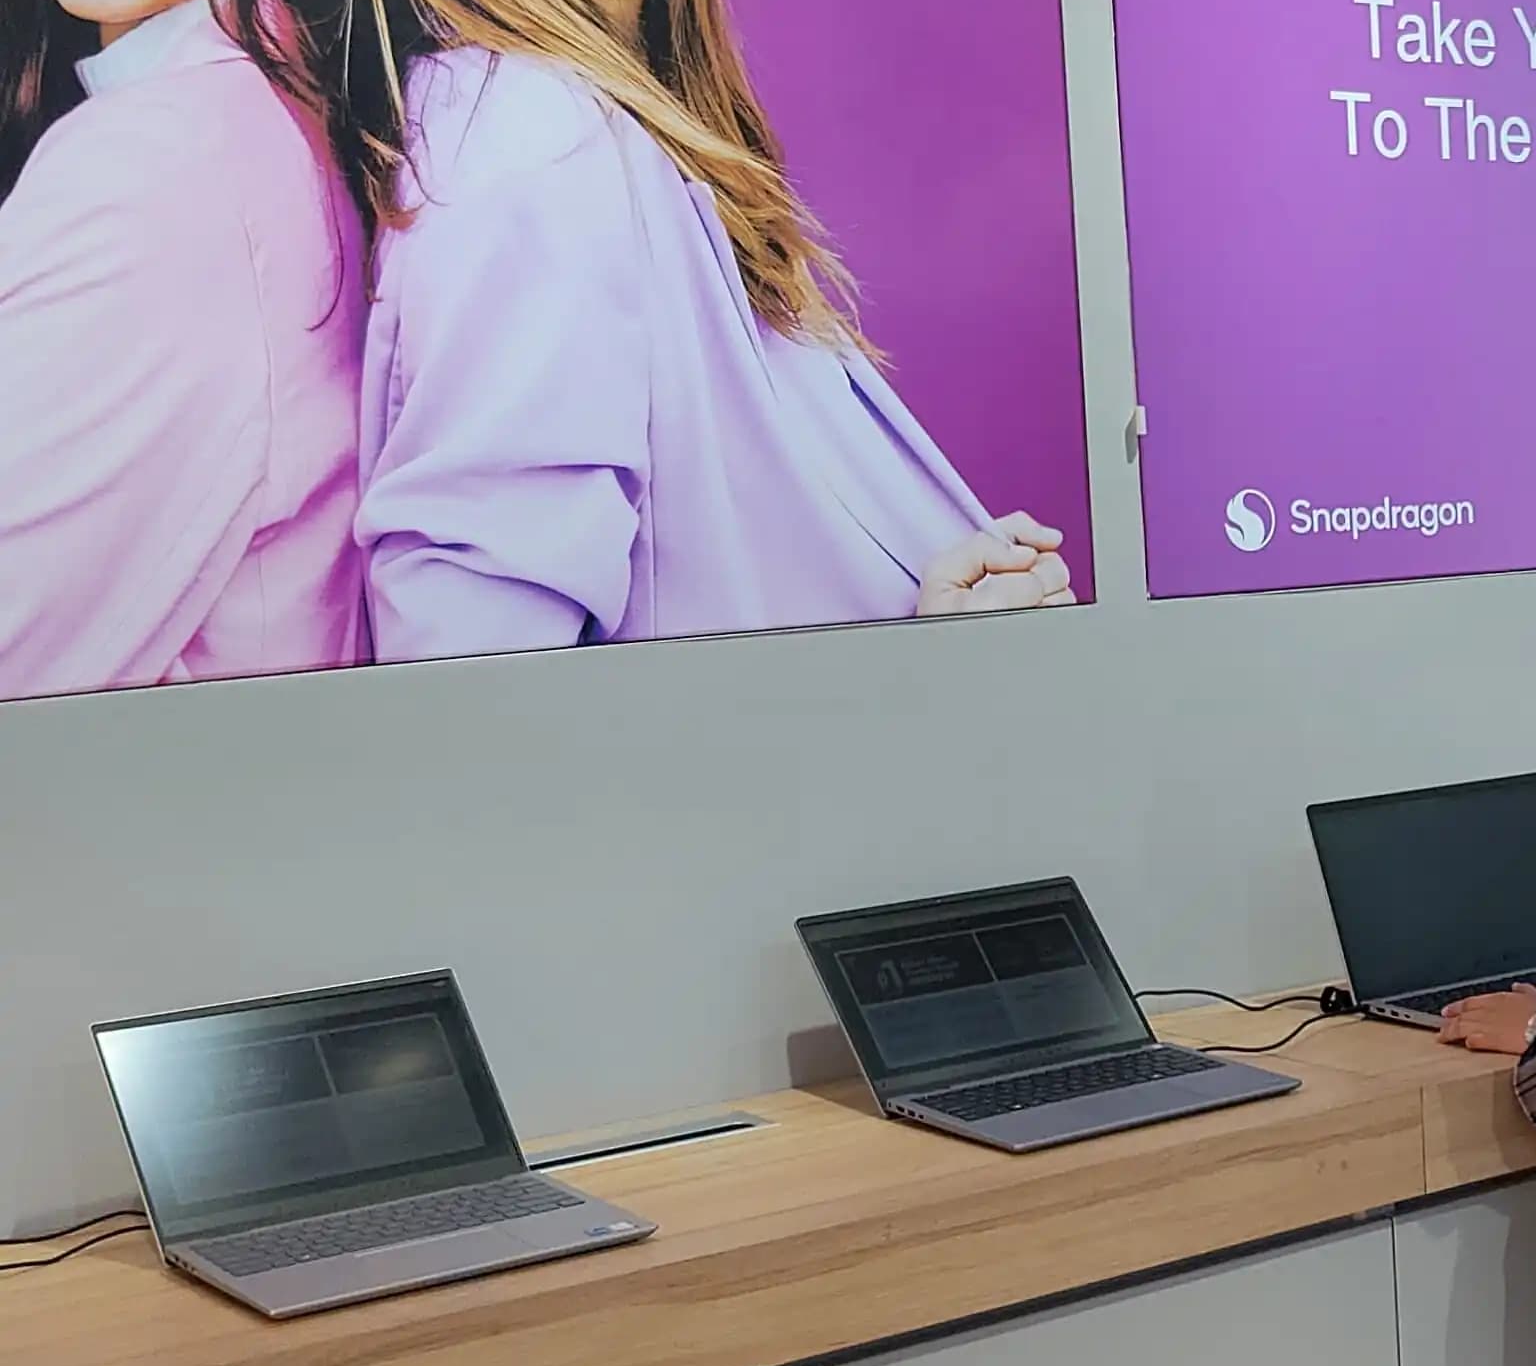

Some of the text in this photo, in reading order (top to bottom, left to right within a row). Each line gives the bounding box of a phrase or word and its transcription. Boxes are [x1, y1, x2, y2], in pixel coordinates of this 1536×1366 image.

[1329, 90, 1408, 160] To
[1424, 97, 1532, 164] The
[1290, 495, 1475, 539] Snapdragon
